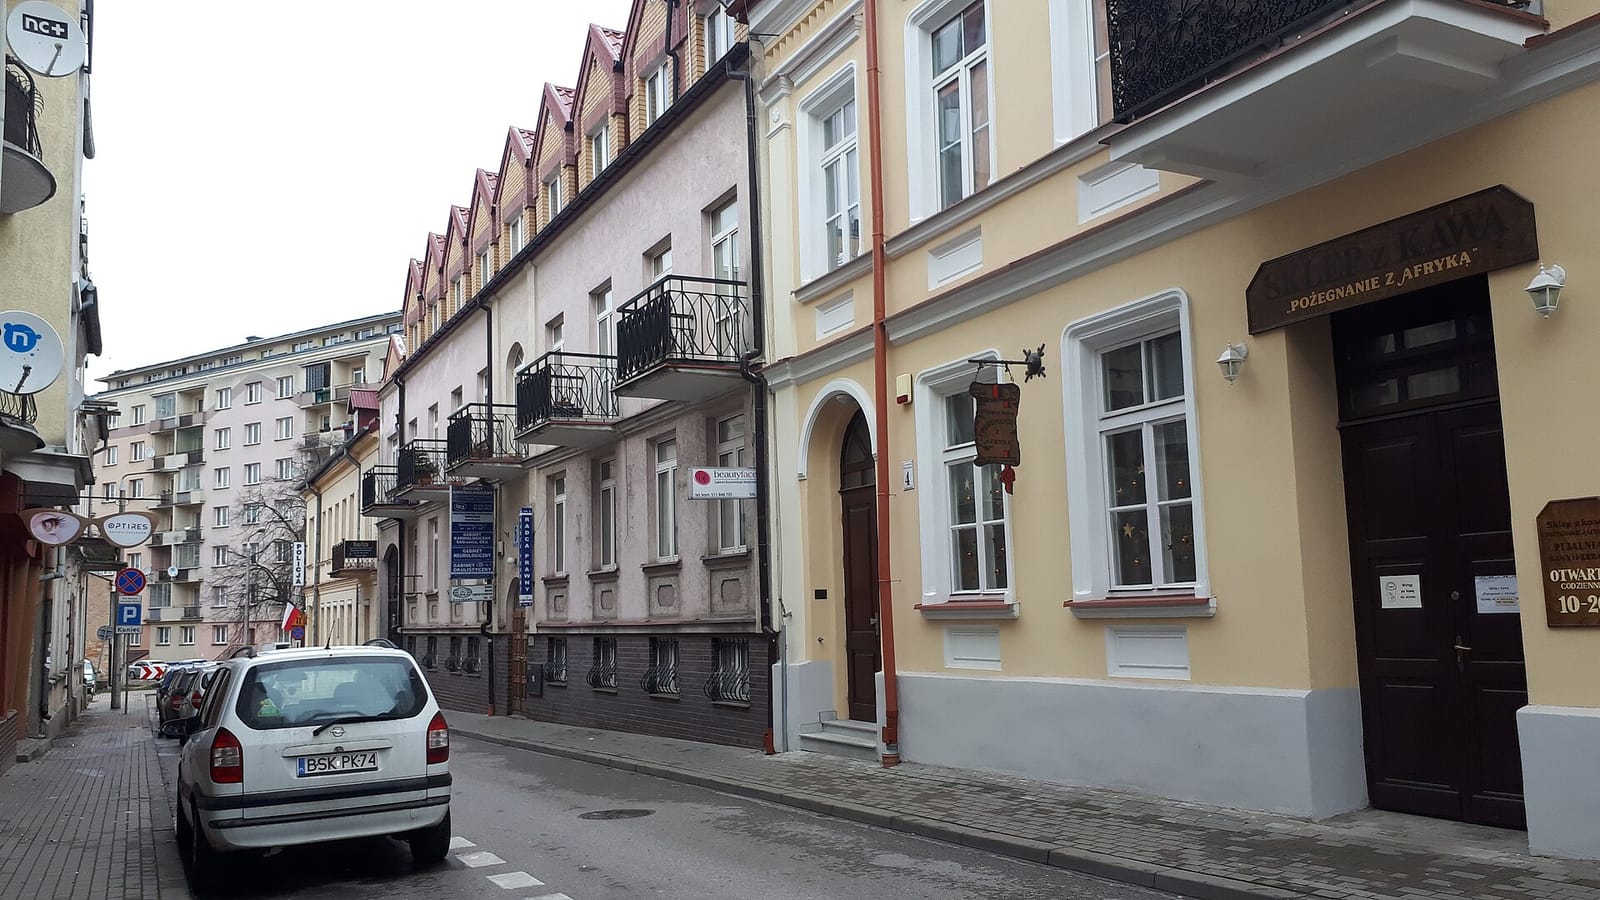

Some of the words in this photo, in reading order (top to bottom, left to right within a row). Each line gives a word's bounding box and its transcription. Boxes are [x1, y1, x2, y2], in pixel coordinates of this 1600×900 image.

[24, 16, 65, 36] nc+
[904, 471, 911, 486] 4
[107, 522, 149, 531] OPTIRES
[295, 543, 303, 585] POLICJA
[523, 553, 531, 592] PRAWNY
[1558, 595, 1600, 614] 10-2
[123, 606, 137, 623] P
[307, 756, 337, 772] BSK
[341, 753, 377, 769] PK74
